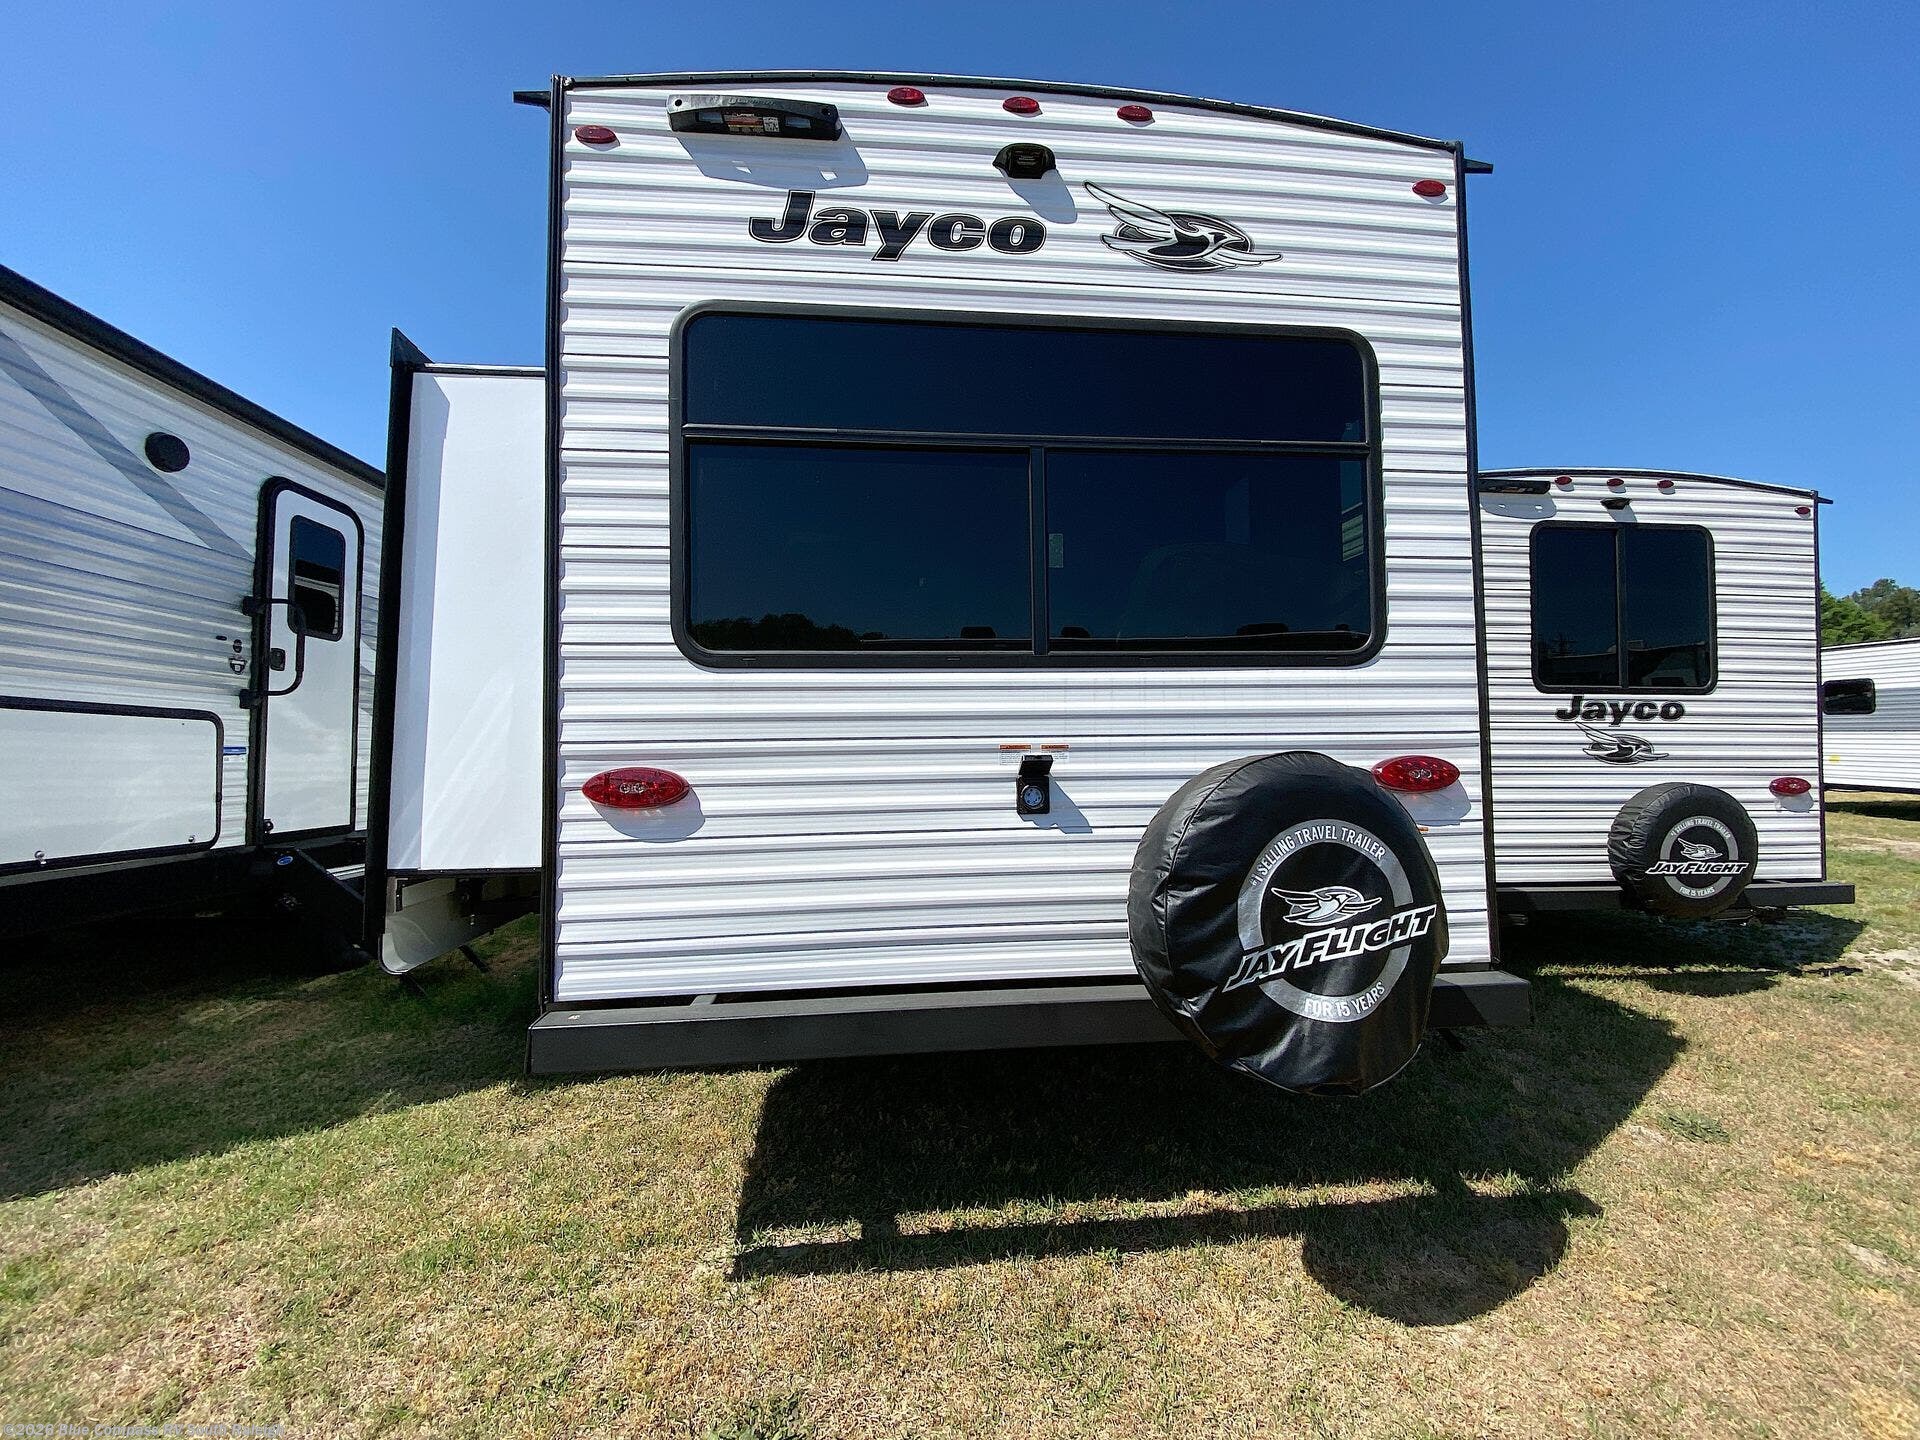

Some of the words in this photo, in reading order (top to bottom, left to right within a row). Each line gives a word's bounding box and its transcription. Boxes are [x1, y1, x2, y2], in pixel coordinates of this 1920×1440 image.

[748, 189, 1047, 262] Jayco
[1555, 694, 1685, 727] Jayco
[1256, 836, 1296, 875] SELLING
[1295, 825, 1338, 845] TRAVEL
[1341, 827, 1386, 861] TRAILER
[1304, 998, 1333, 1018] FOR
[1336, 1000, 1351, 1017] 15
[1350, 981, 1386, 1015] YEARS
